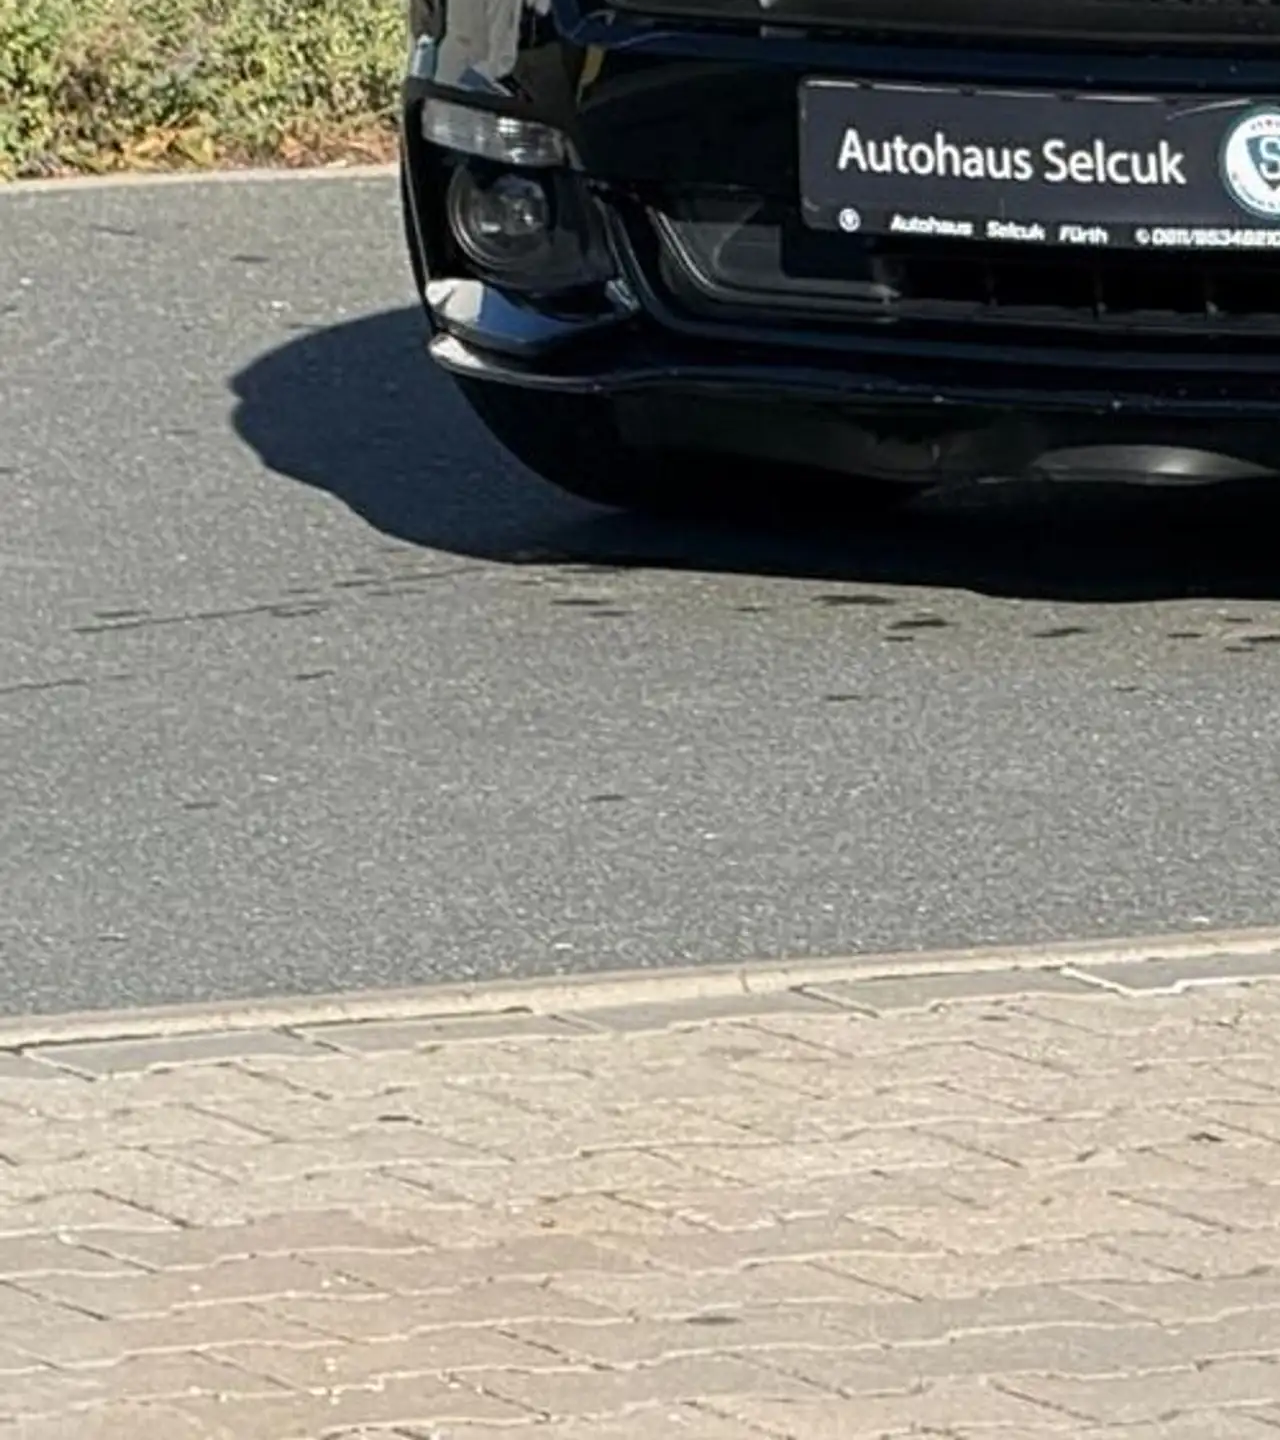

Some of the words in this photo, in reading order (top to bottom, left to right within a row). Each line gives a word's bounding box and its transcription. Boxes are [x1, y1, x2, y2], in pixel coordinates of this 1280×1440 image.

[837, 127, 1035, 181] Autohaus
[1041, 138, 1188, 185] Selcuk
[889, 213, 974, 237] Autohaus
[985, 219, 1047, 241] Selcuk
[1058, 224, 1110, 245] Fürth
